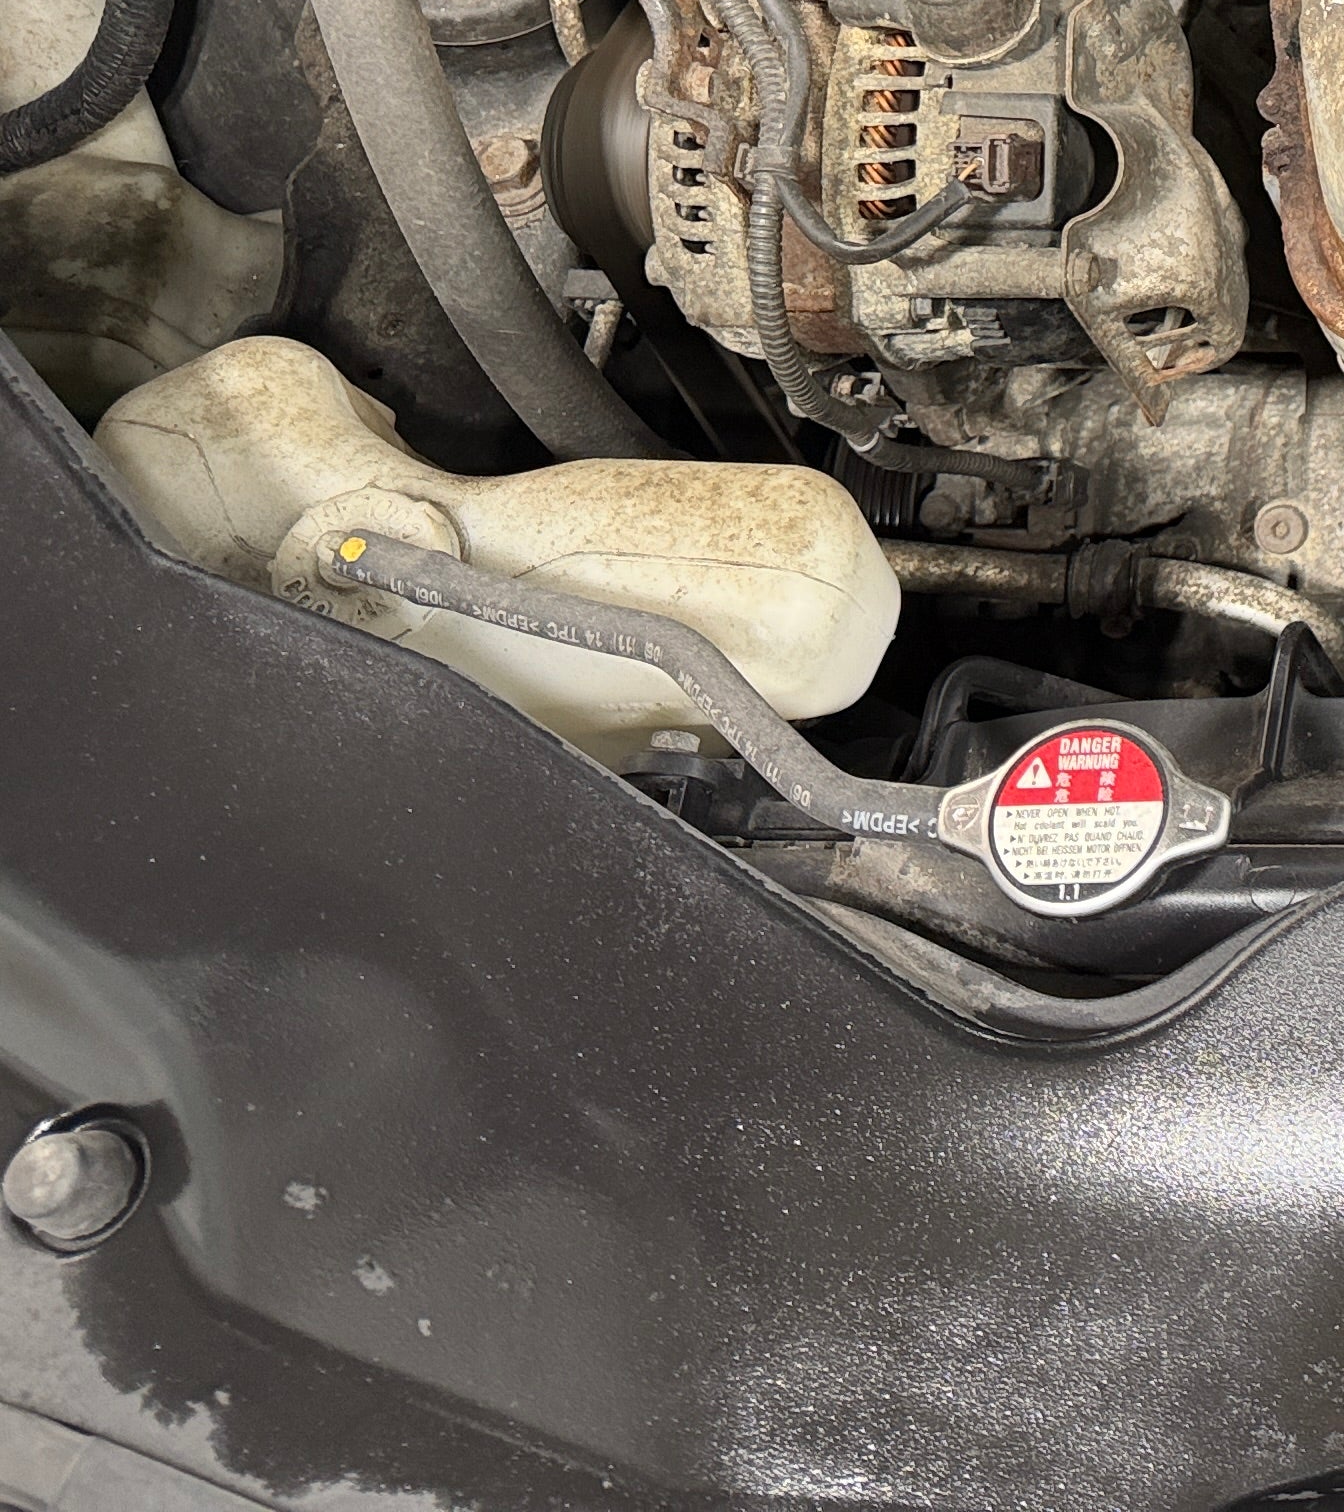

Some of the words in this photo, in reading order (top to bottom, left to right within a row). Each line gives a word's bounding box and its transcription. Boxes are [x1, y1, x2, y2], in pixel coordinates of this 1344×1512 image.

[472, 604, 539, 632] >EPDM<
[546, 621, 581, 644] TPC
[584, 629, 603, 648] 14
[719, 715, 742, 748] TPC
[1060, 736, 1122, 754] DANGER
[1058, 754, 1120, 770] WARNUNG
[1015, 809, 1041, 819] NEVER
[1047, 808, 1069, 818] OPEN
[1076, 807, 1098, 816] WHEN
[842, 809, 921, 836] >EPDM<
[1094, 818, 1116, 828] scald
[1064, 833, 1079, 842] PAS
[1011, 847, 1033, 856] NICHT
[1086, 844, 1111, 854] MOTOR
[1059, 883, 1080, 901] 1.1
